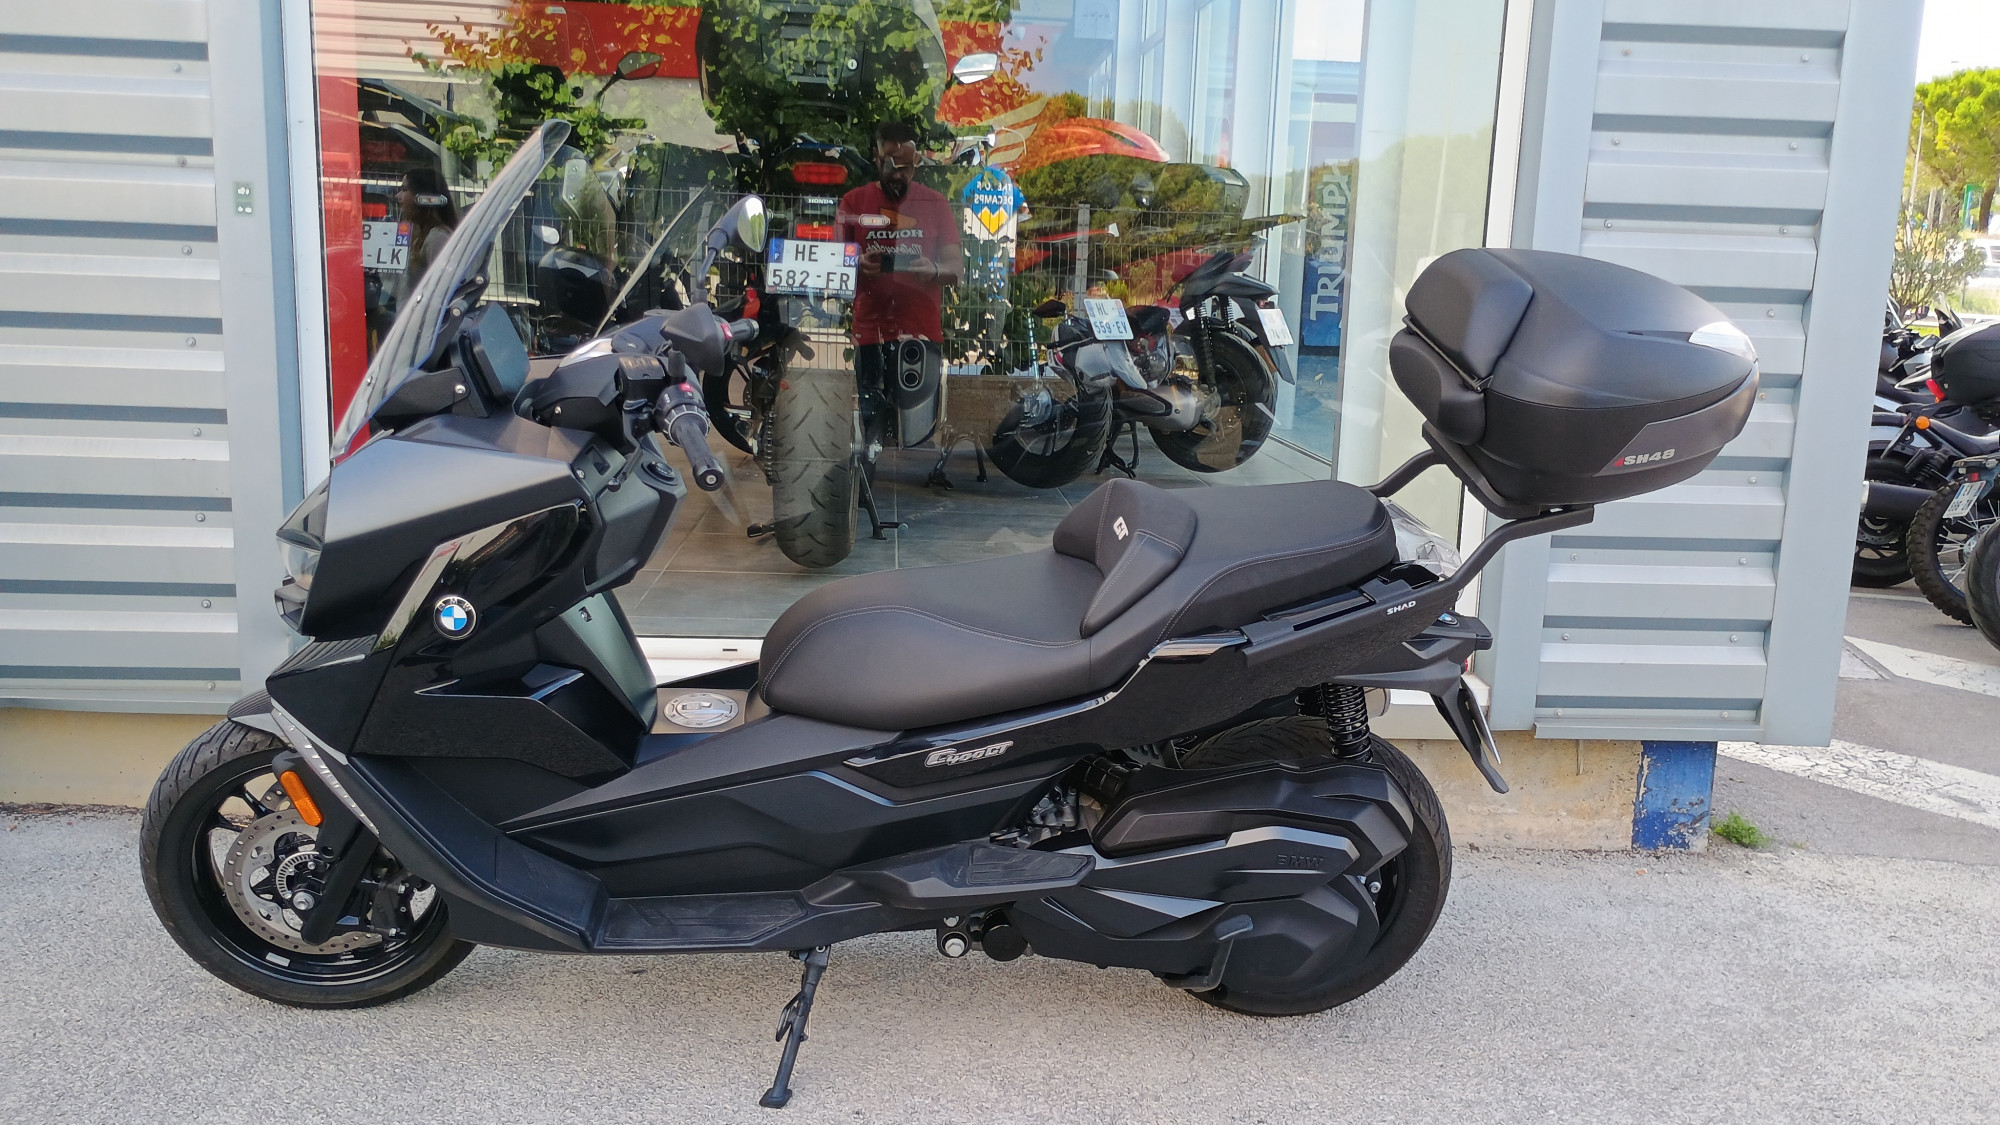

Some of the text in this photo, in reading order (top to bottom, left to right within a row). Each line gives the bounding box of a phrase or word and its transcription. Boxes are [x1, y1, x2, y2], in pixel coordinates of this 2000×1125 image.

[397, 235, 408, 245] 34
[1310, 158, 1350, 321] TRIUMPH
[844, 256, 856, 267] 34
[772, 268, 851, 290] 582-FR
[1623, 448, 1676, 466] SH48
[437, 596, 473, 611] BMW
[1386, 600, 1417, 616] SHAD
[1277, 854, 1324, 869] BMW
